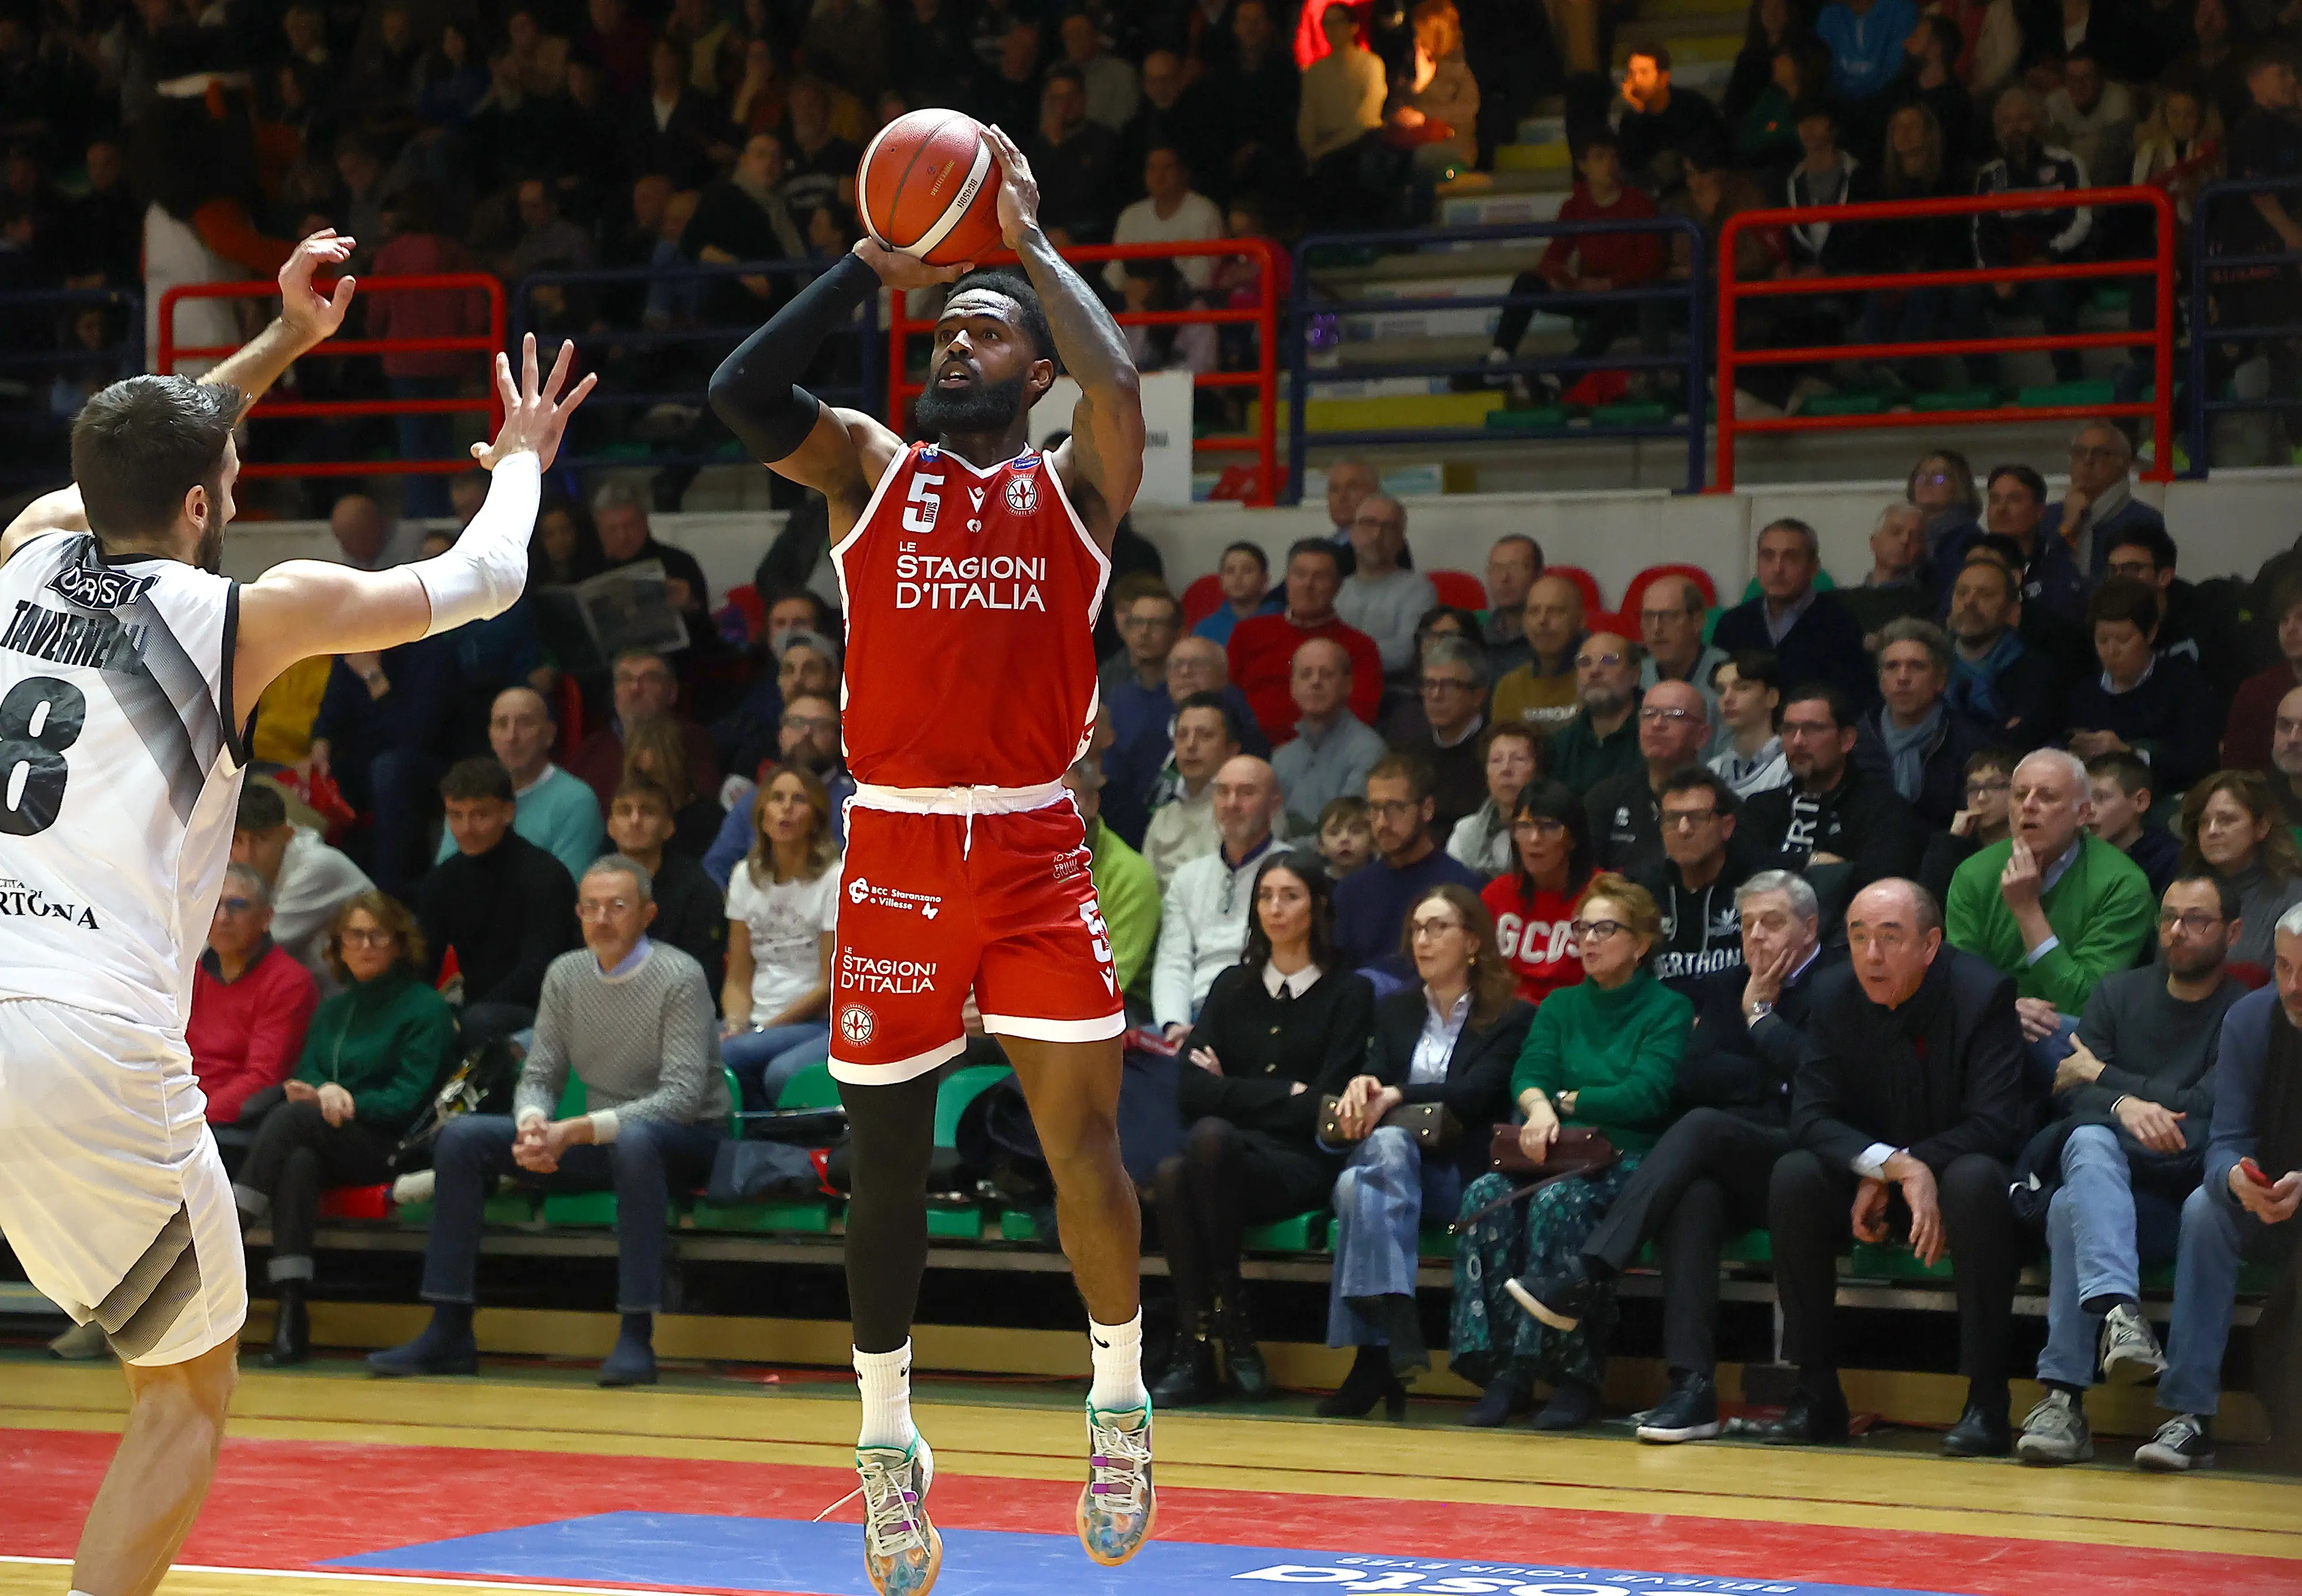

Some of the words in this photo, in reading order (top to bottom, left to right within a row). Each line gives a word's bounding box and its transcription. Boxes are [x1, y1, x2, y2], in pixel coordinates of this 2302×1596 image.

[902, 471, 945, 533] 5
[923, 502, 938, 523] DAVIS
[899, 541, 917, 552] LE
[896, 555, 1046, 581] STAGIONI
[896, 582, 1046, 612] D'ITALIA
[0, 676, 86, 837] 8
[871, 886, 889, 896] BCC
[891, 889, 942, 903] Staranzano
[879, 896, 913, 910] Villesse
[1496, 911, 1581, 965] GCD
[844, 945, 853, 954] LE
[843, 954, 937, 977] STAGIONI
[841, 971, 935, 994] D'ITALIA
[1335, 1556, 1451, 1570] EYES
[1459, 1564, 1590, 1580] YOUR
[1604, 1574, 1798, 1594] BELIEVE
